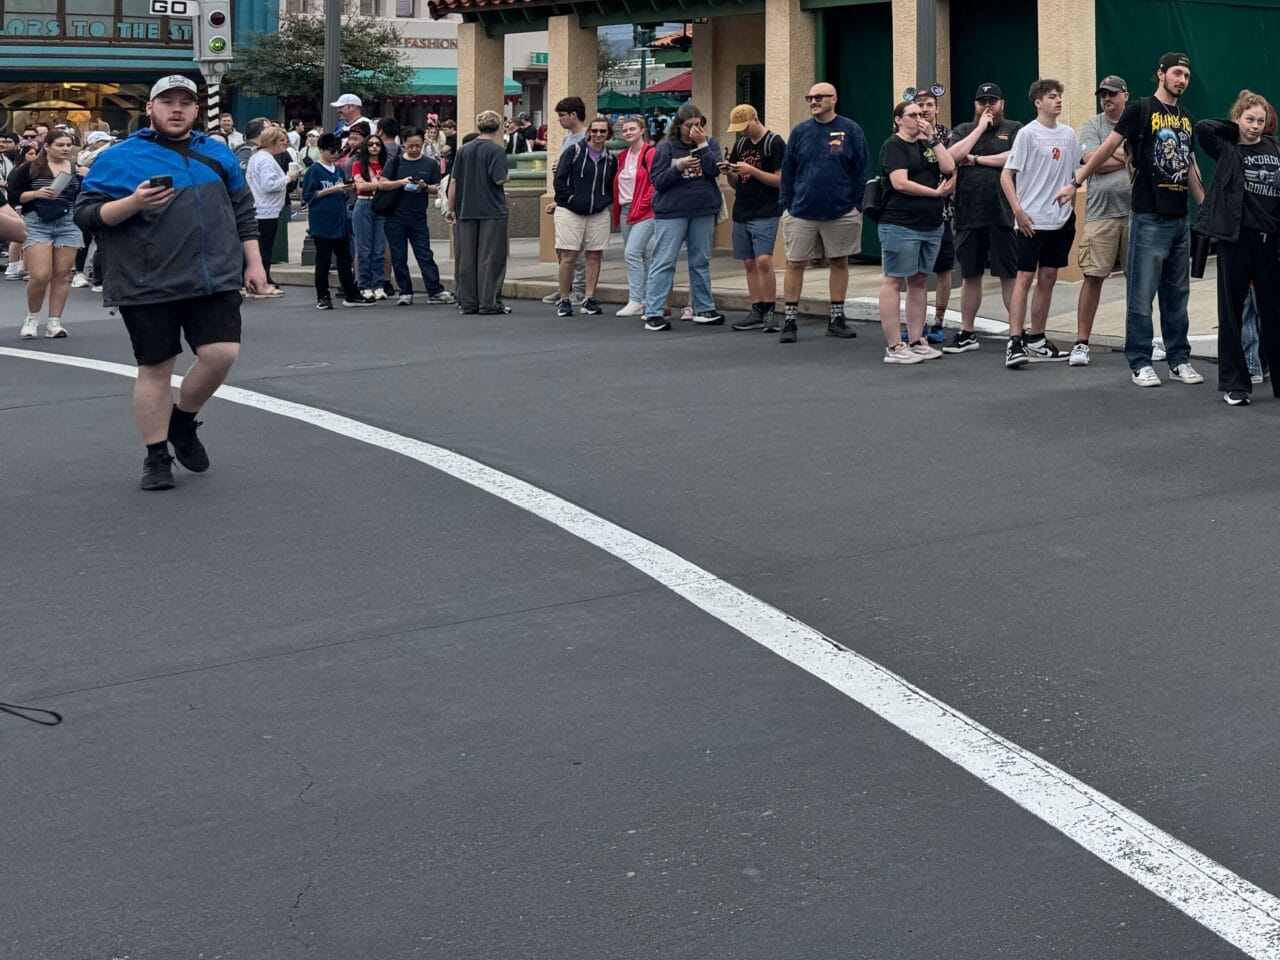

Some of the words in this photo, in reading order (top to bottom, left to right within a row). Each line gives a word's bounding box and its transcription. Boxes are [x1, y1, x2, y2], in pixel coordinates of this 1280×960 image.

[152, 0, 187, 14] GO
[0, 19, 61, 36] ORS
[72, 21, 106, 38] TO
[118, 22, 161, 38] THE
